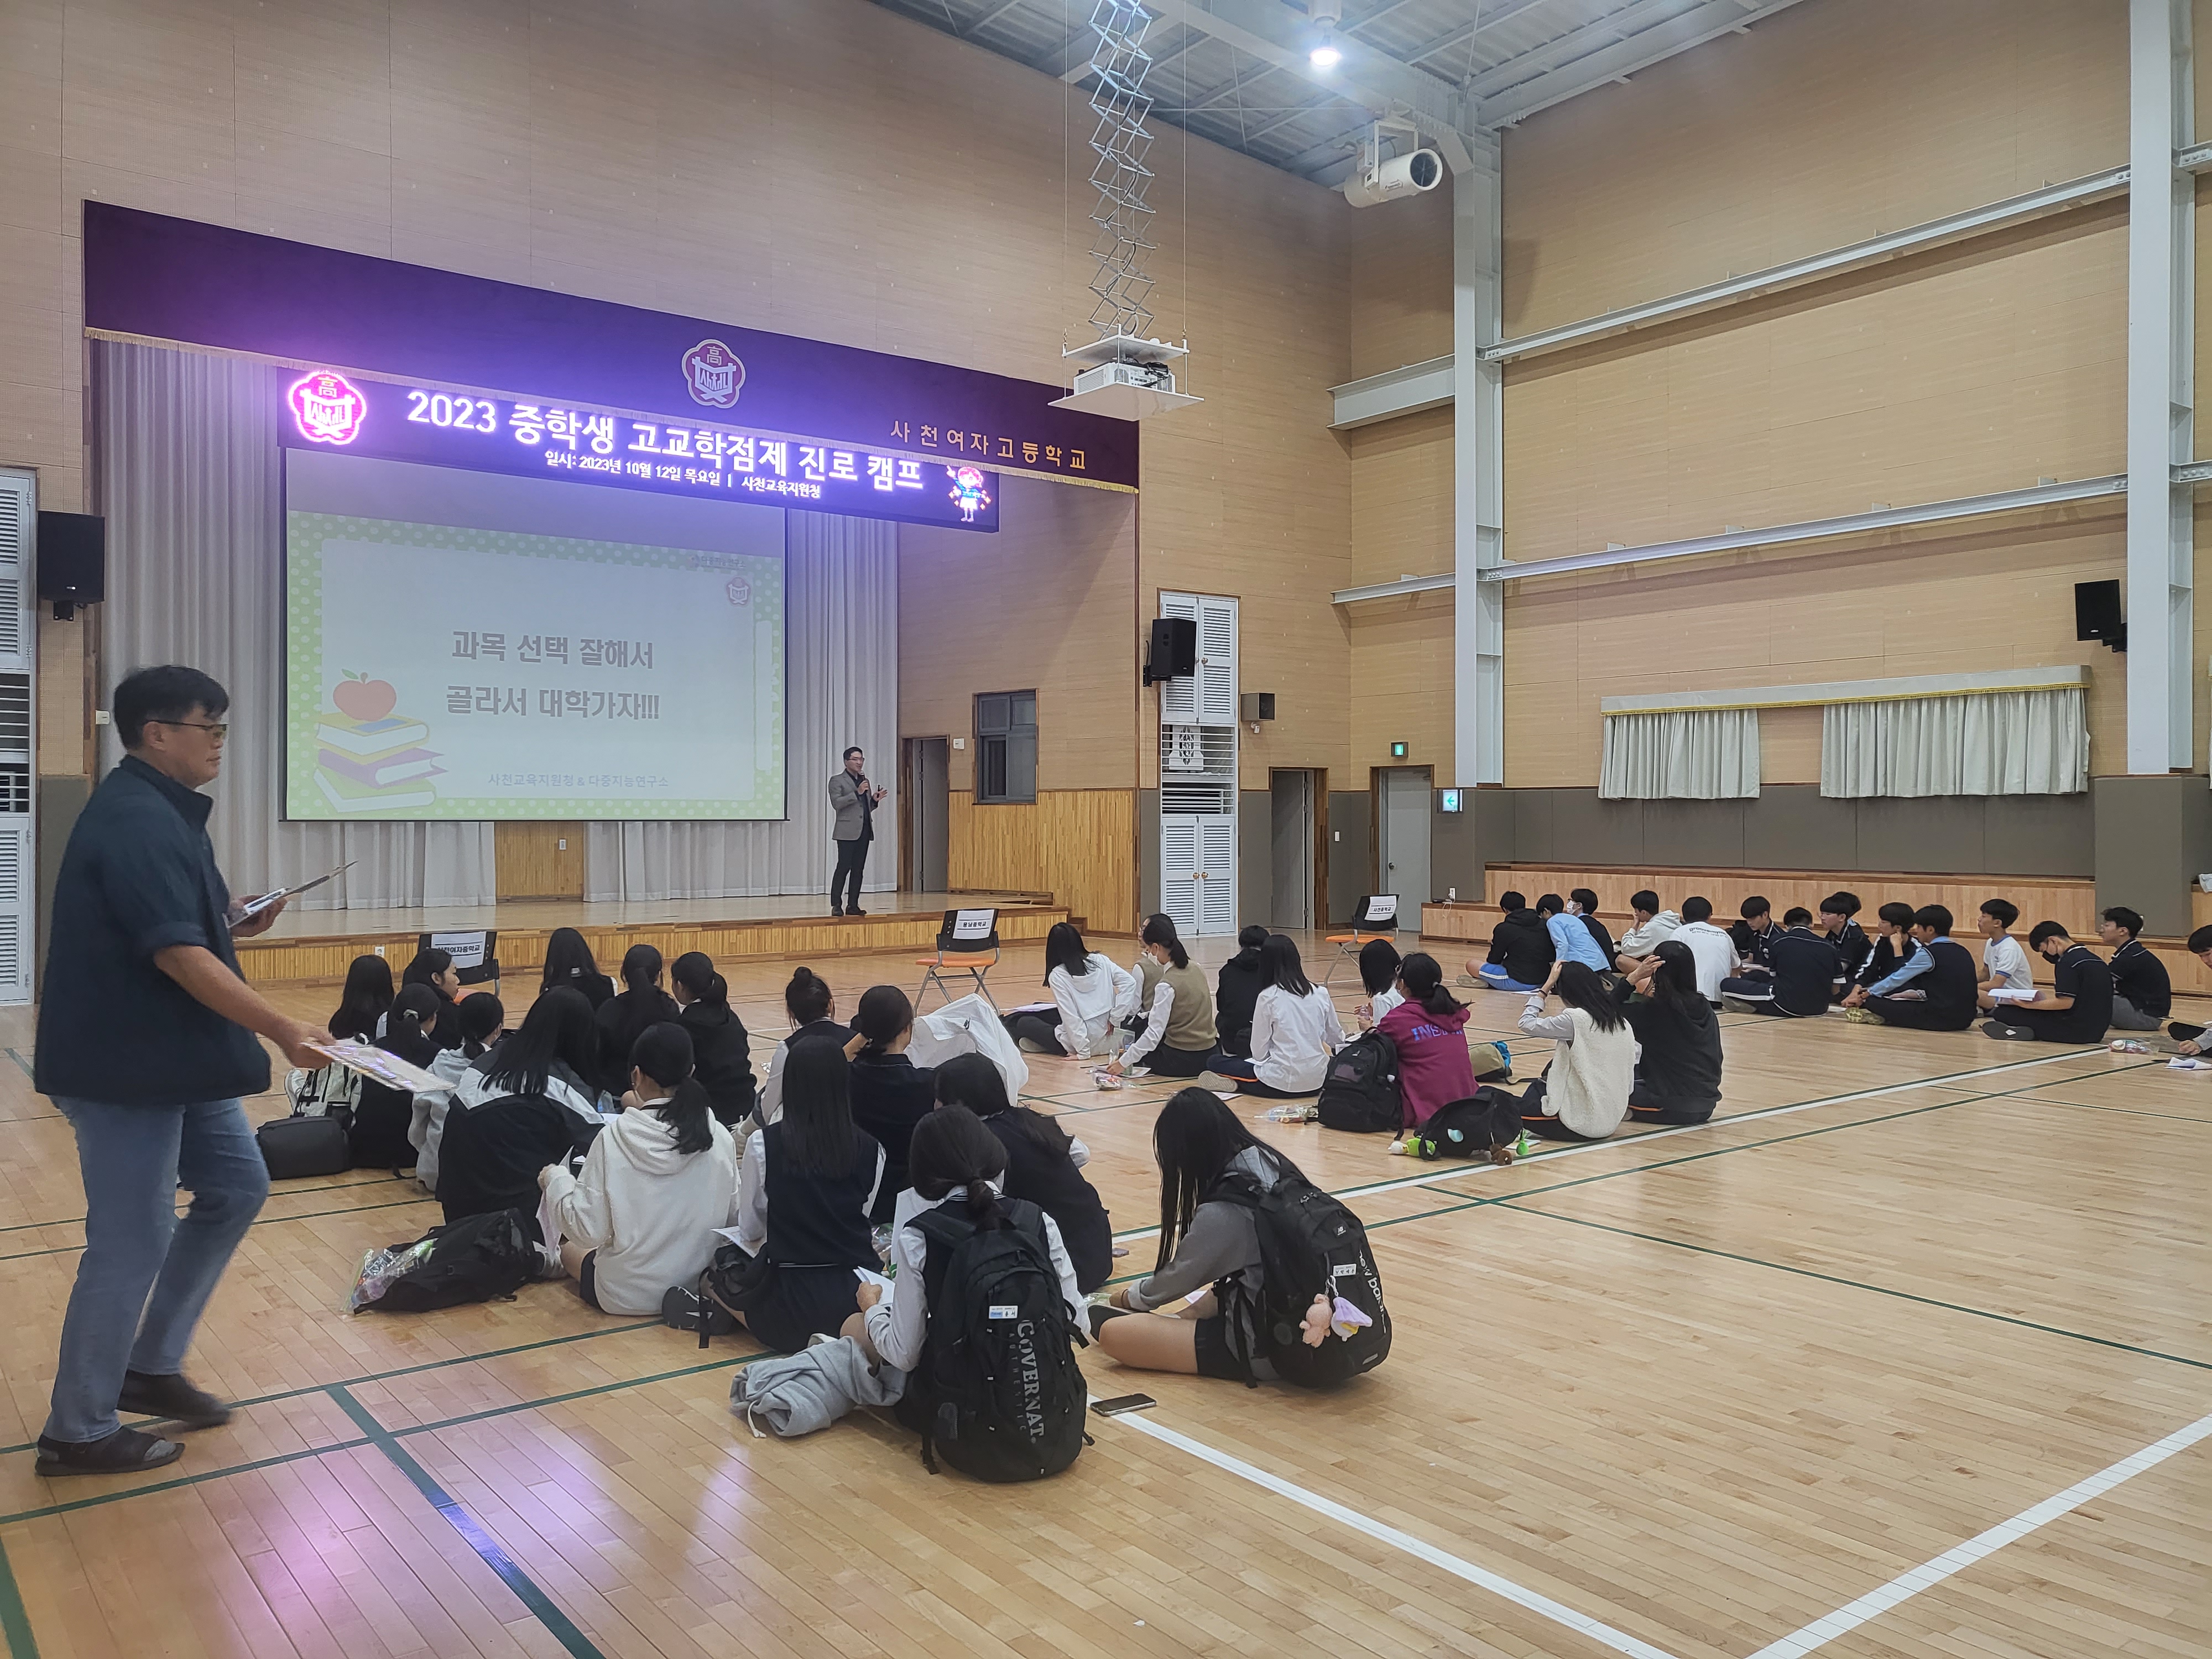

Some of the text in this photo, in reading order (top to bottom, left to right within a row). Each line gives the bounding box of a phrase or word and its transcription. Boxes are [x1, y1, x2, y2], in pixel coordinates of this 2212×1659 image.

[408, 391, 923, 491] 2023 중학생 고교학점제 진로 캠프
[890, 421, 1086, 469] 사천여자고등학교
[545, 450, 576, 469] 일시:
[578, 457, 621, 474] 2023년
[625, 462, 651, 478] 10월
[655, 465, 681, 481] 12일
[684, 468, 721, 486] 목요일
[741, 476, 821, 498] 사천교육지원청
[452, 630, 653, 669] 과목 선택 잘해서
[446, 685, 660, 720] 골라서 대학가자!!!
[488, 774, 669, 788] 사천교육지원청 & 다중지능연구소
[438, 945, 480, 953] 천여자중학교
[1017, 1319, 1045, 1436] COVERNAT
